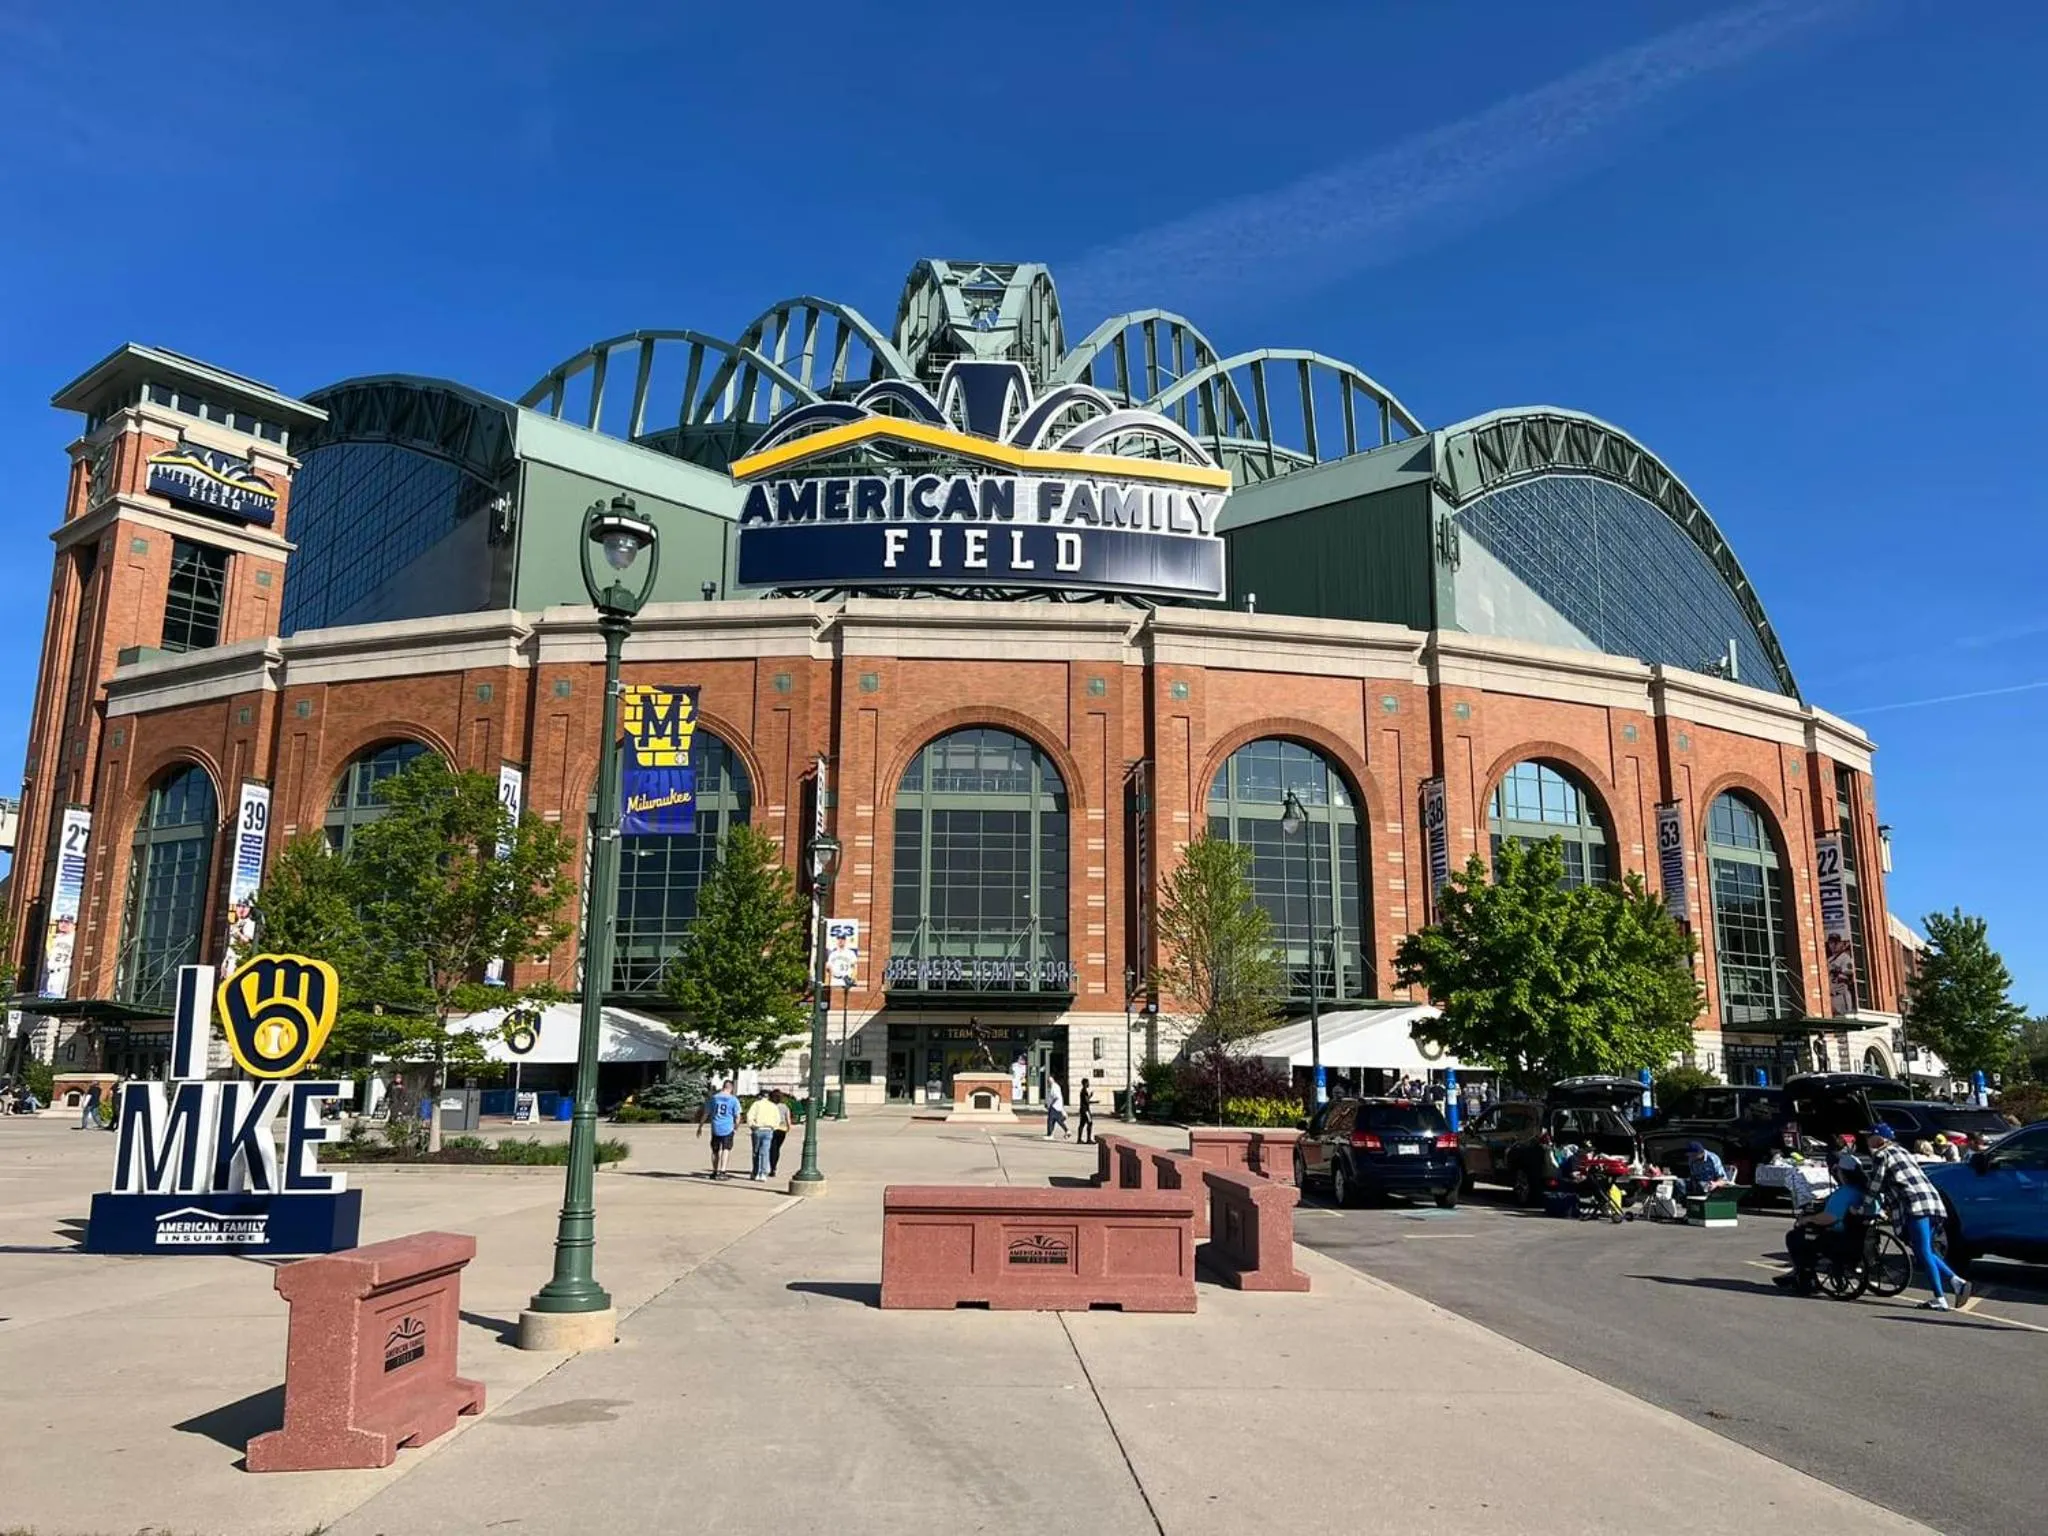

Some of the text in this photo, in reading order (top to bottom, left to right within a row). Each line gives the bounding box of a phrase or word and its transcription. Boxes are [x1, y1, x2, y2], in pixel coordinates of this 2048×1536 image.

[189, 487, 241, 511] FIELD
[740, 476, 1223, 535] AMERICAN FAMILY
[883, 528, 1082, 572] FIELD
[626, 787, 692, 815] Milwaukee
[1427, 795, 1444, 829] 38
[243, 800, 266, 831] 39
[65, 823, 91, 854] 27
[1660, 820, 1680, 848] 53
[1817, 847, 1839, 878] 22
[830, 924, 855, 937] 53
[885, 959, 1074, 984] BREWERS TEAM STORE
[948, 1028, 1009, 1039] TEAM TORE
[714, 1104, 727, 1115] 19
[112, 1080, 354, 1195] MKE
[157, 1222, 266, 1233] AMERICAN FAMILY
[165, 1234, 256, 1242] INSURANCE
